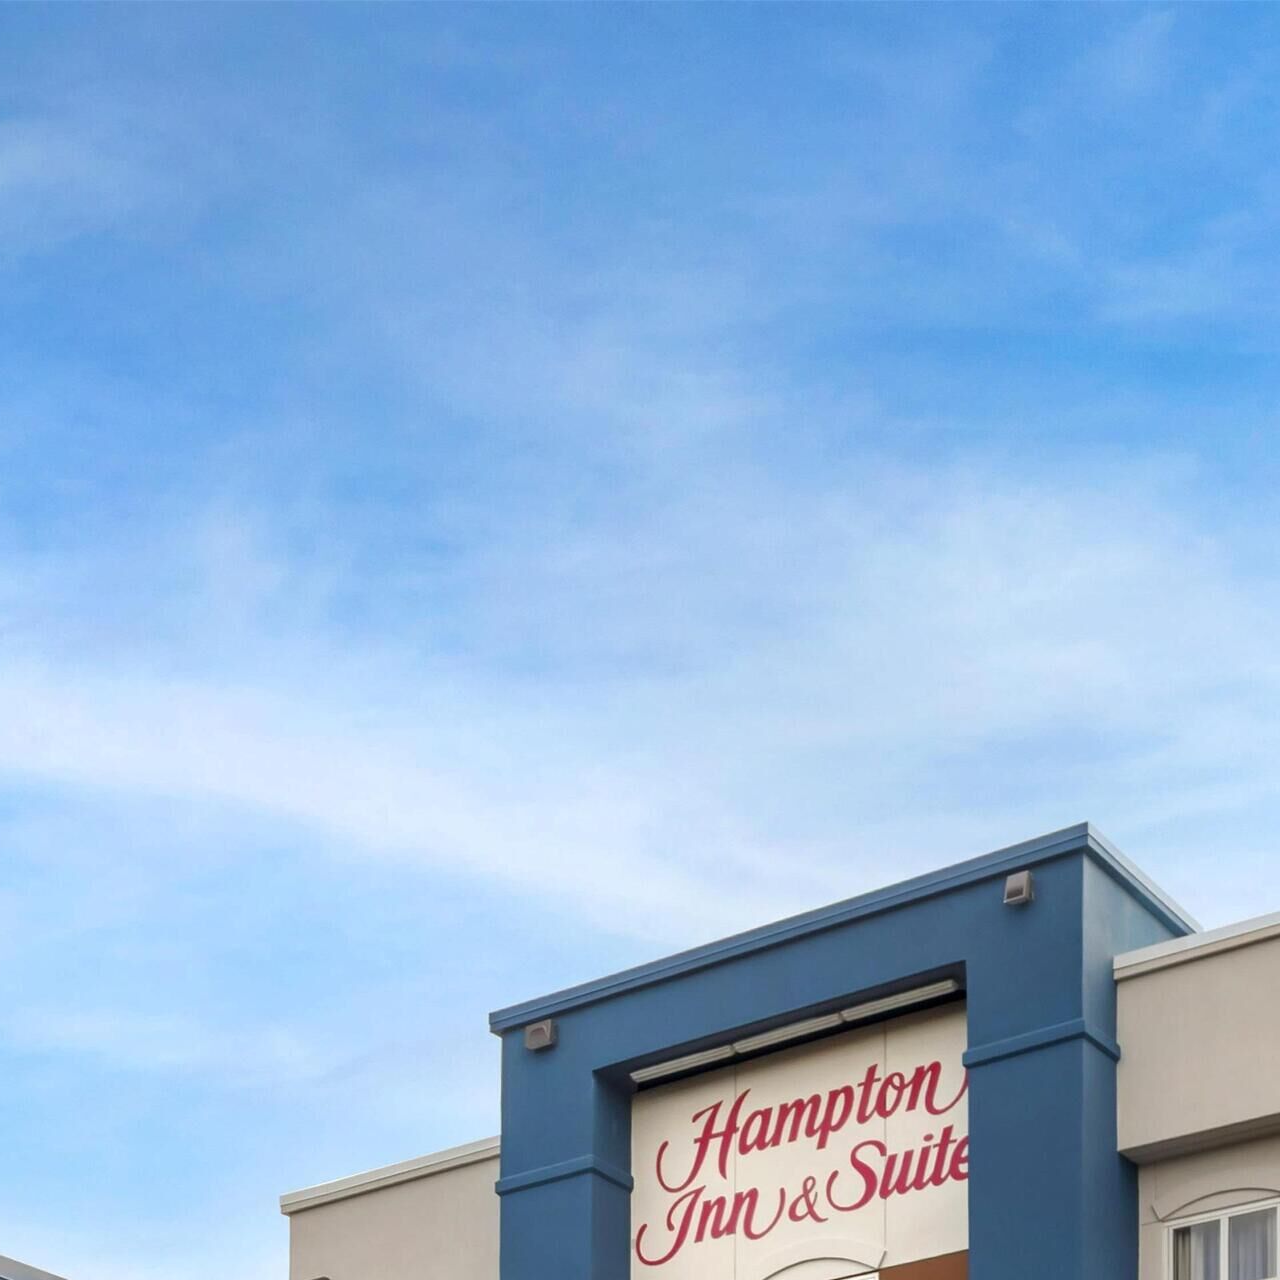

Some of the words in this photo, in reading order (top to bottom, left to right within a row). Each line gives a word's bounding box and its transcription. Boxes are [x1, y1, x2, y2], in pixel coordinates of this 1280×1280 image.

[656, 1060, 968, 1193] Hampton
[635, 1184, 786, 1266] Inn
[788, 1175, 828, 1223] &
